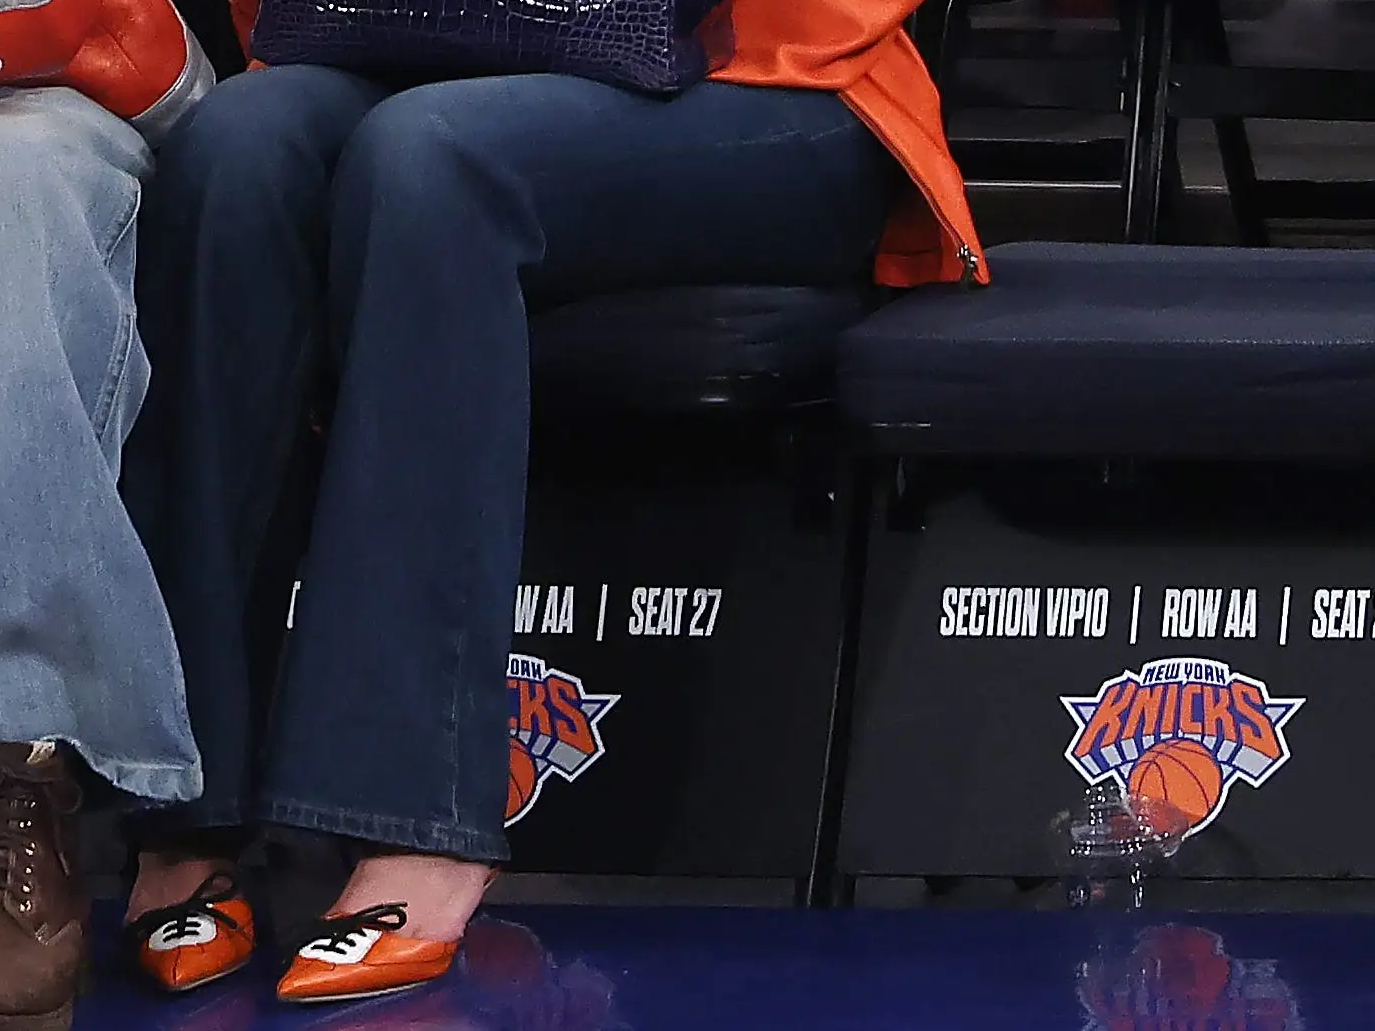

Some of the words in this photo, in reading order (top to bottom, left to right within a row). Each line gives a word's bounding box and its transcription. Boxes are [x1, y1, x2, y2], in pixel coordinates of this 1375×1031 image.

[541, 585, 574, 634] AA
[628, 587, 688, 636] SEAT
[688, 588, 722, 637] 27
[939, 586, 1040, 637] SECTION
[1046, 587, 1109, 638] VIP10
[1161, 588, 1223, 638] ROW
[1223, 589, 1257, 638] AA
[1311, 589, 1371, 638] SEAT
[509, 659, 543, 679] ORK
[1142, 662, 1181, 685] NEW
[1184, 662, 1227, 685] YORK
[1074, 682, 1281, 760] KNICKS
